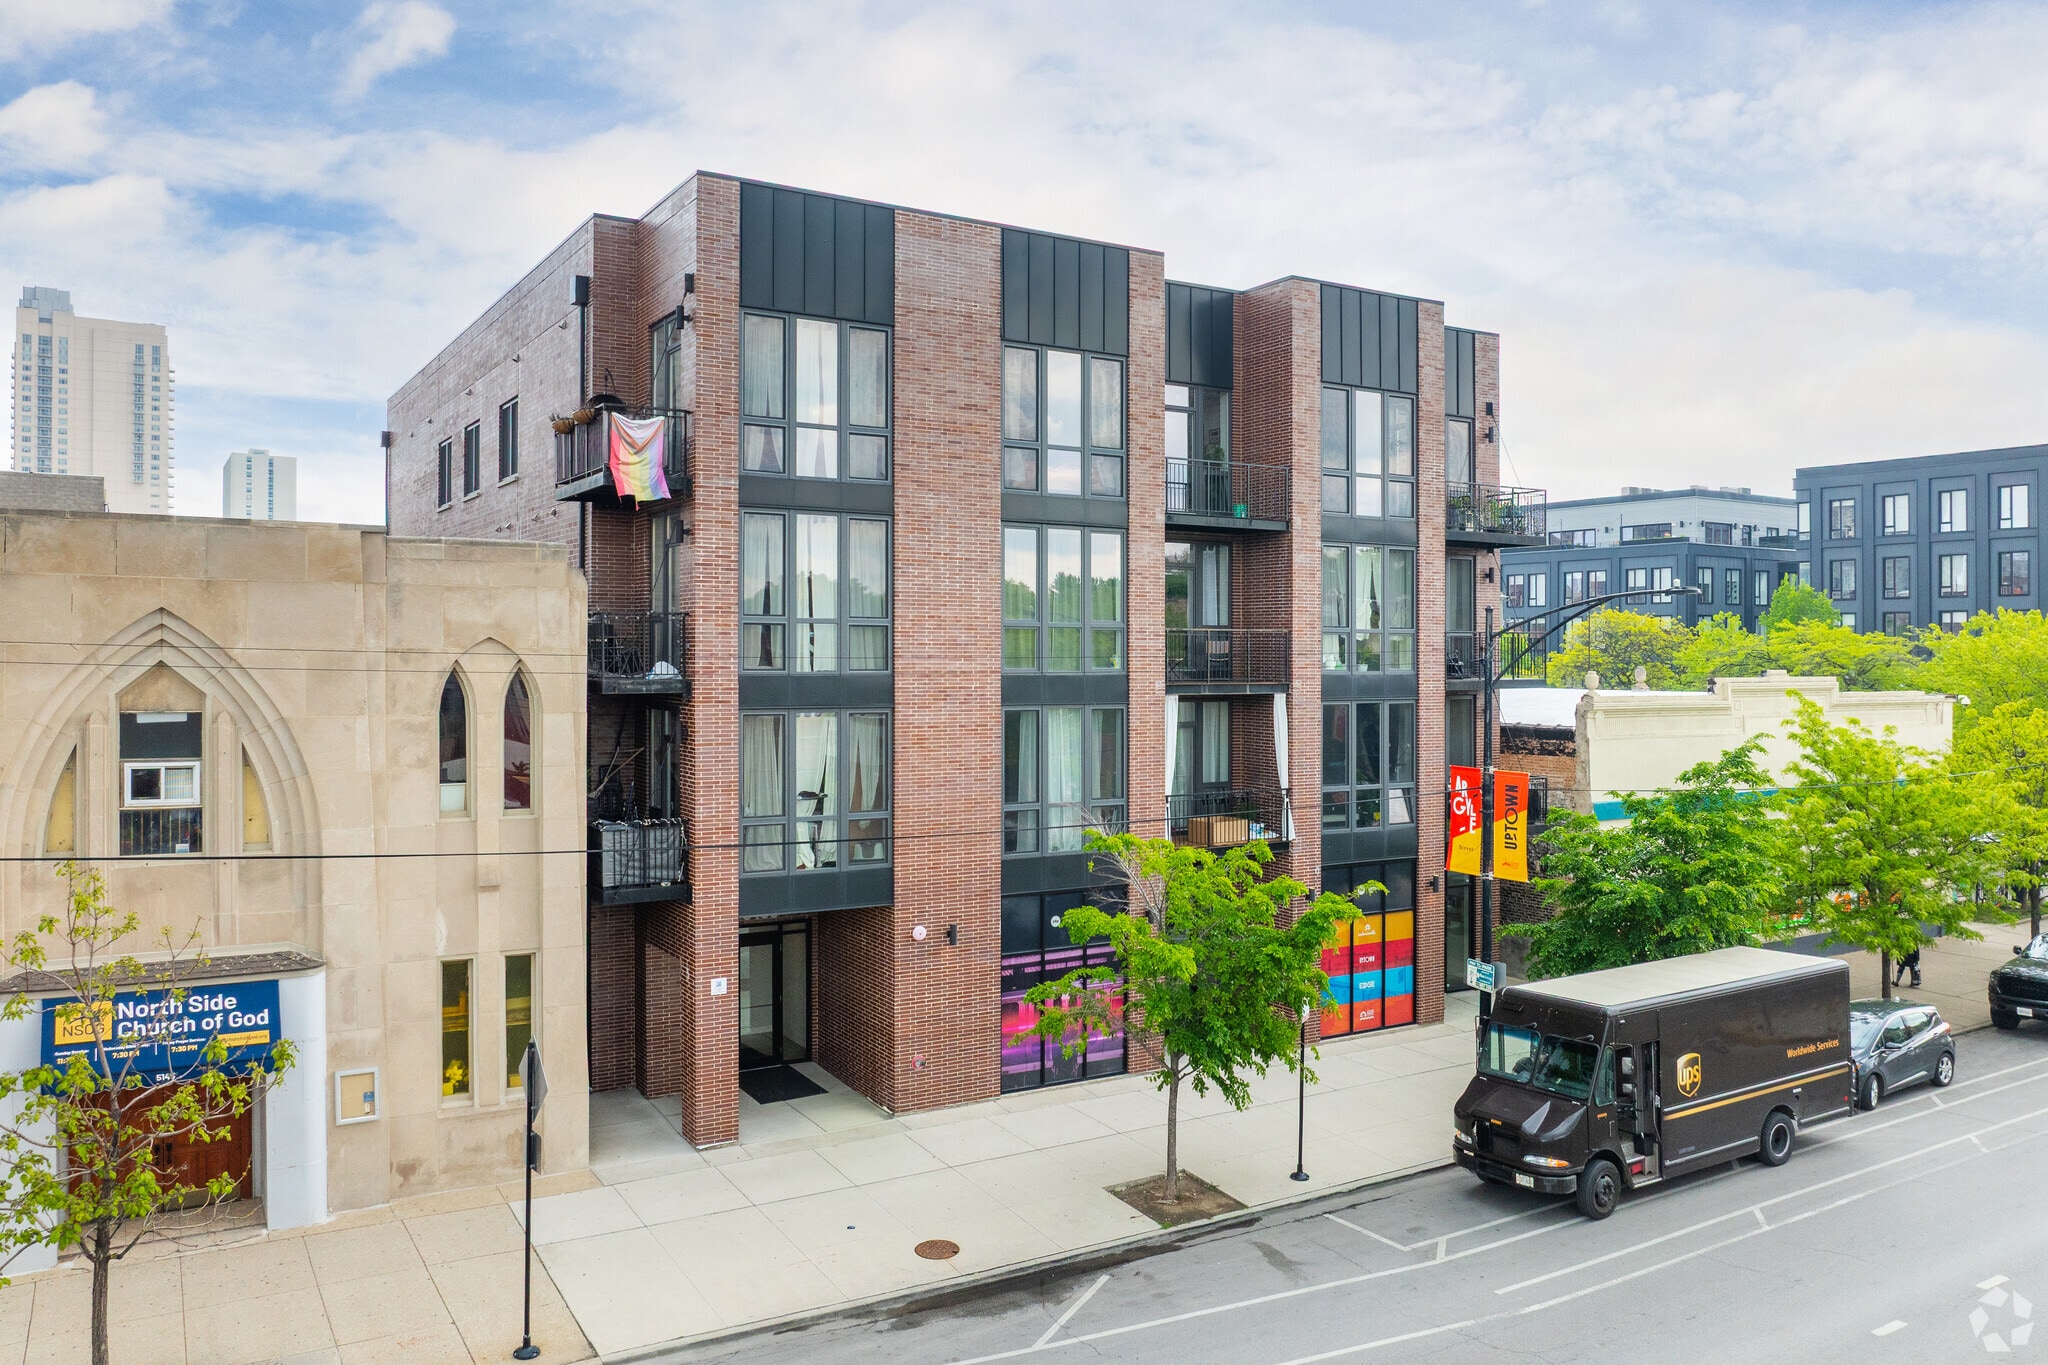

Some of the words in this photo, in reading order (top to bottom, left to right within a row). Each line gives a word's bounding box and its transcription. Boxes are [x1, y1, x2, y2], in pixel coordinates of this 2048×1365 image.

[1504, 784, 1519, 850] UPTOWN
[118, 998, 183, 1020] North
[188, 993, 237, 1013] Side
[117, 1016, 196, 1038] Church
[201, 1013, 224, 1031] of
[228, 1008, 269, 1028] God
[112, 1051, 128, 1059] 7:30
[171, 1045, 186, 1053] 7:30
[1786, 1043, 1817, 1059] Worldwide
[1816, 1038, 1840, 1051] Services
[156, 1073, 176, 1082] 514
[1679, 1064, 1700, 1091] ups
